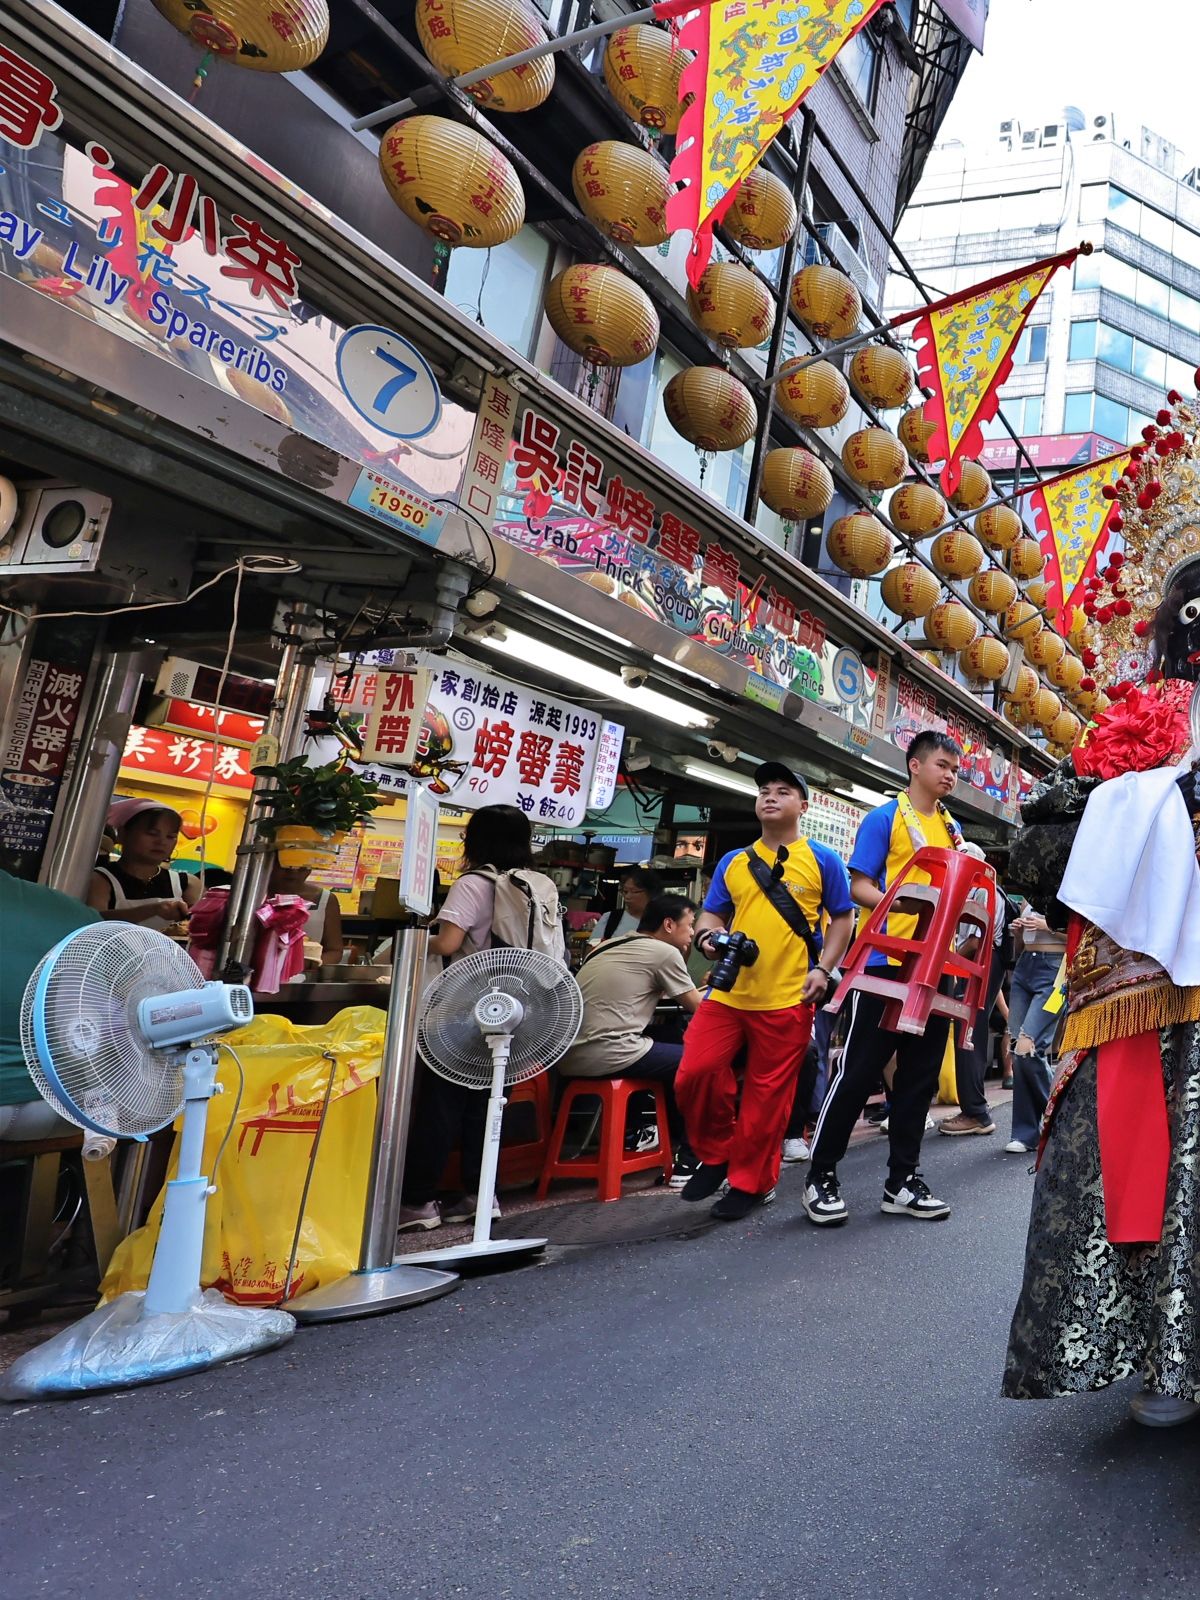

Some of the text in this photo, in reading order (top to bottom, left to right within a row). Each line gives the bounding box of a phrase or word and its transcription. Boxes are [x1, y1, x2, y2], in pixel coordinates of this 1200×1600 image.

[64, 241, 128, 304] Lily
[147, 291, 288, 392] Spareribs
[373, 347, 418, 415] 7
[468, 385, 512, 516] 基隆廟口
[378, 492, 424, 524] 1950
[526, 518, 578, 554] Crab
[593, 548, 643, 591] Thick
[653, 584, 696, 627] Soup
[708, 617, 772, 665] Glutinous
[778, 658, 795, 681] Oil
[801, 672, 826, 697] Rice
[5, 661, 49, 769] FIRE-EXTINGUISHER
[29, 668, 83, 752] 滅火器
[375, 672, 415, 754] 外帶
[838, 656, 859, 696] 5
[875, 655, 890, 729] 基隆廟口
[468, 777, 490, 795] 90
[471, 717, 587, 797] 螃蟹羹
[412, 811, 431, 897] 內用
